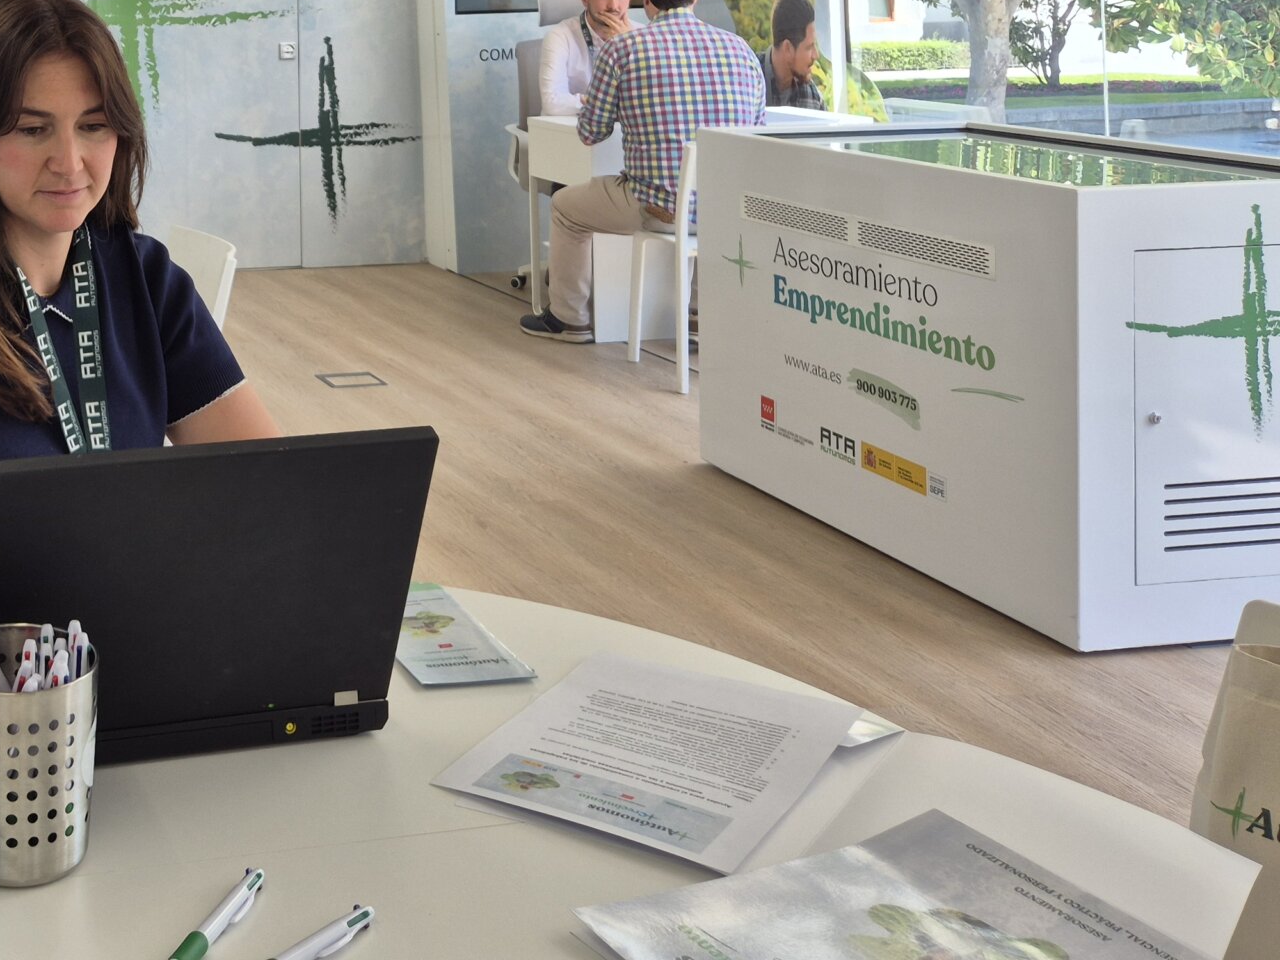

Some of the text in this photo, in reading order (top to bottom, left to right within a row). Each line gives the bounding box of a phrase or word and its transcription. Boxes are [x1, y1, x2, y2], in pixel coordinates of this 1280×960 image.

[479, 47, 515, 62] COM
[72, 261, 91, 308] ATA
[773, 236, 938, 307] Asesoramiento
[773, 274, 996, 371] Emprendimiento
[36, 333, 58, 381] ATA
[78, 330, 96, 379] ATA
[784, 353, 917, 412] www.ata.es 900 903 775
[57, 401, 81, 453] ATA
[85, 401, 105, 450] ATA
[820, 426, 855, 457] ATA
[966, 843, 1053, 895] PERSONALIZADO
[1014, 885, 1113, 943] ASESORAMIENTO
[1055, 893, 1064, 902] Y
[1062, 897, 1123, 933] PRÁCTICO
